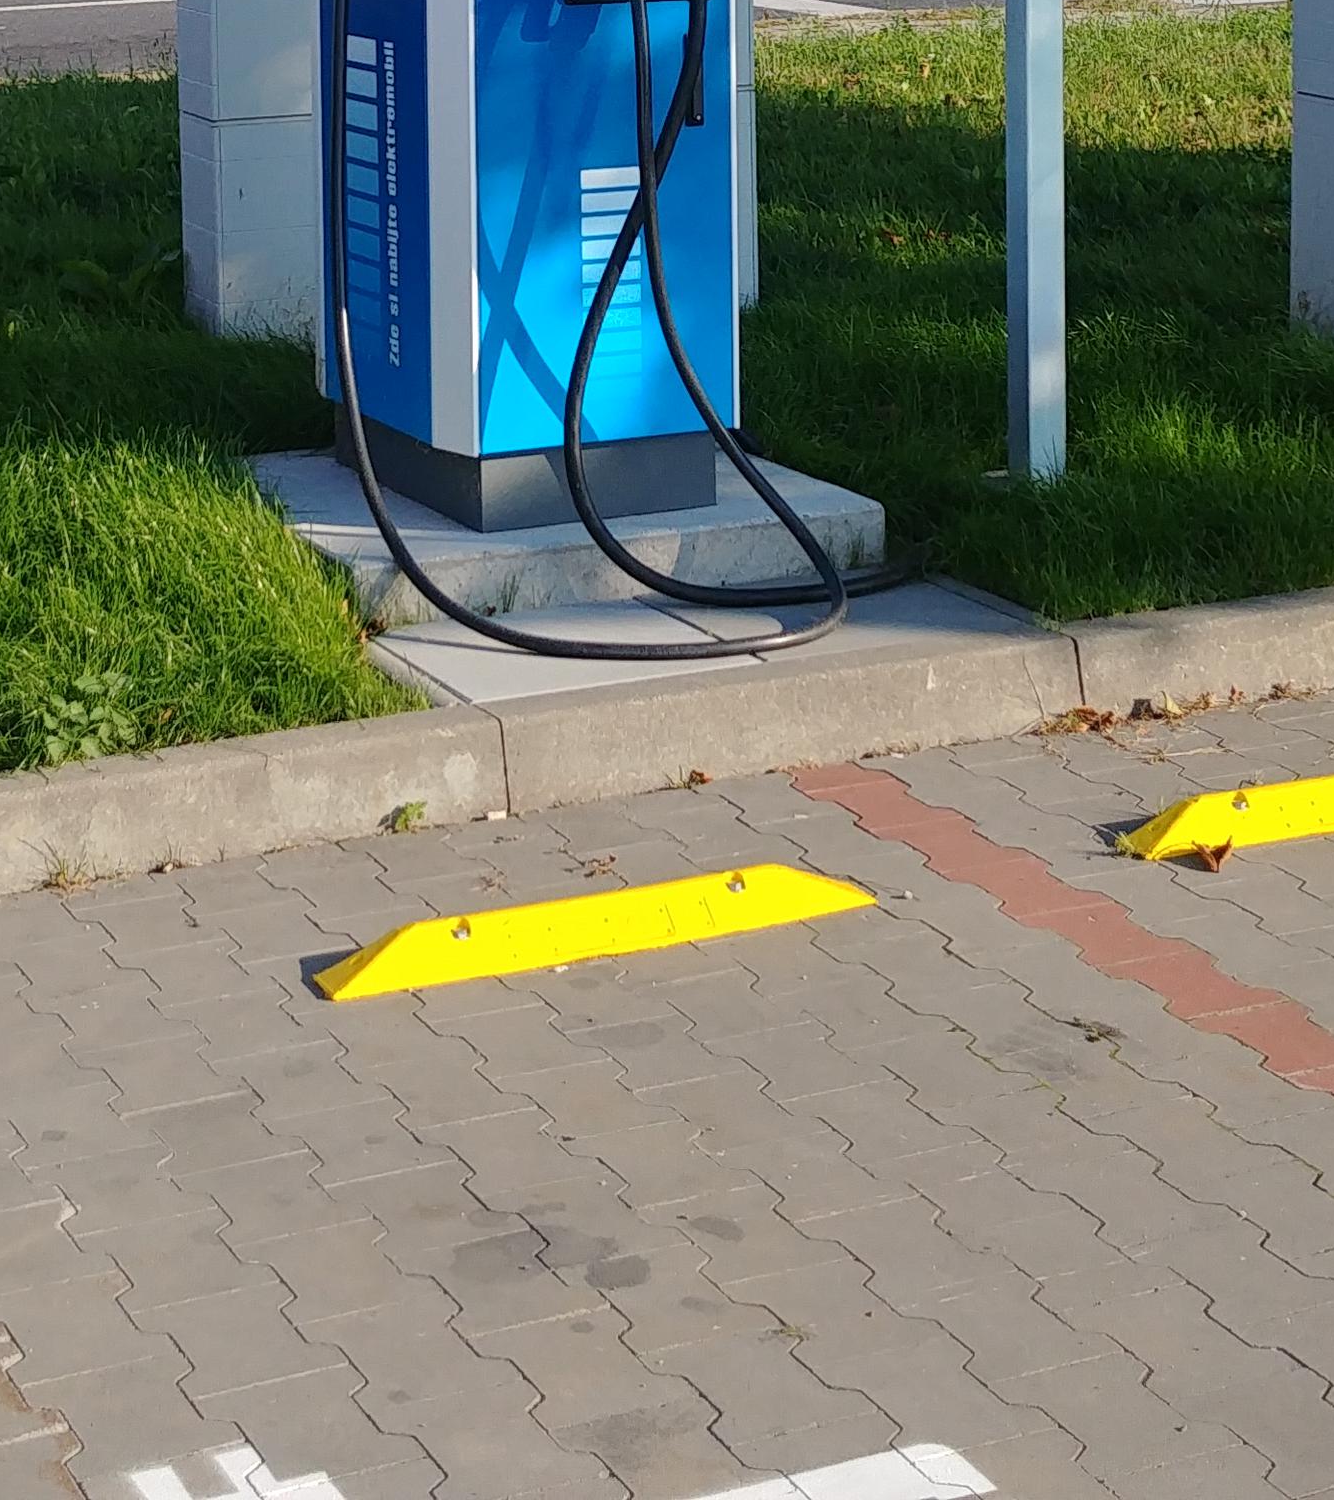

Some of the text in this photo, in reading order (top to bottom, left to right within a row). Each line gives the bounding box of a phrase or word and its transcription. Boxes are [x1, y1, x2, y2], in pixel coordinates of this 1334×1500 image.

[382, 41, 398, 197] elektromobil
[387, 291, 400, 316] si
[388, 324, 401, 368] zde
